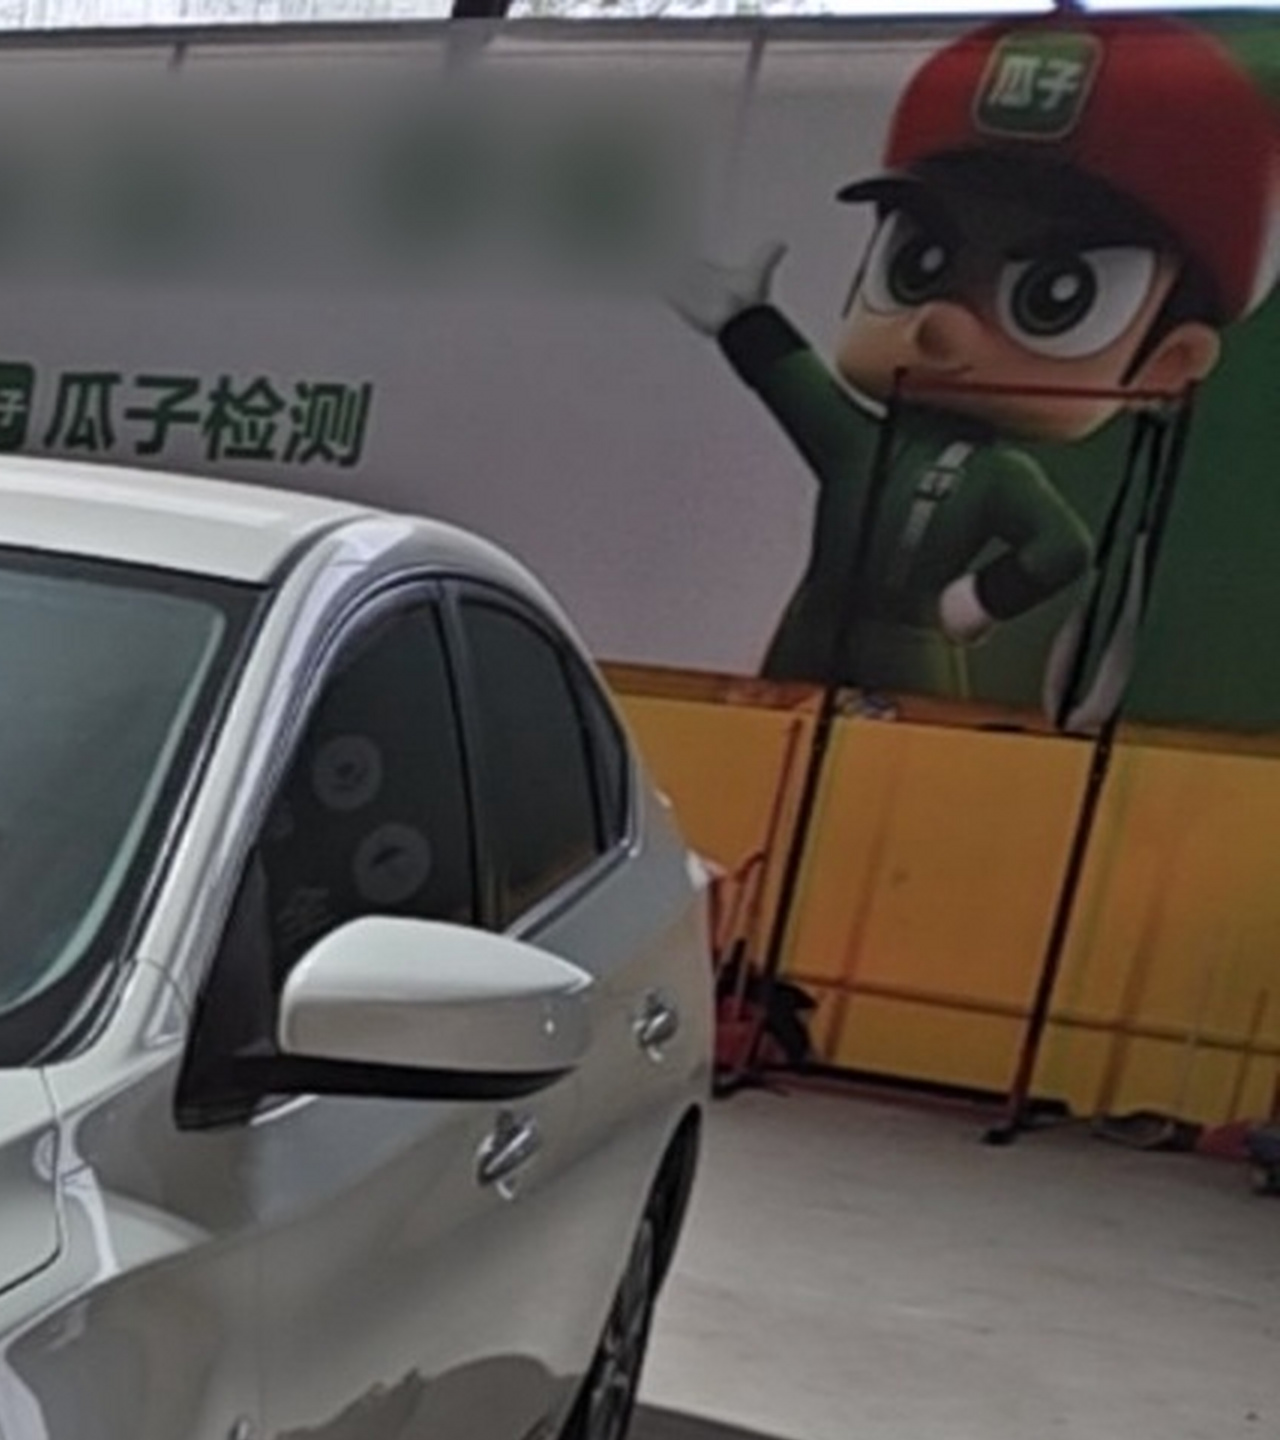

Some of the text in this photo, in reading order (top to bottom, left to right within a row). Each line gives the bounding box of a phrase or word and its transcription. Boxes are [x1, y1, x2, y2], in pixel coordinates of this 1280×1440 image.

[987, 56, 1082, 110] 瓜子
[44, 372, 373, 467] 瓜子检测
